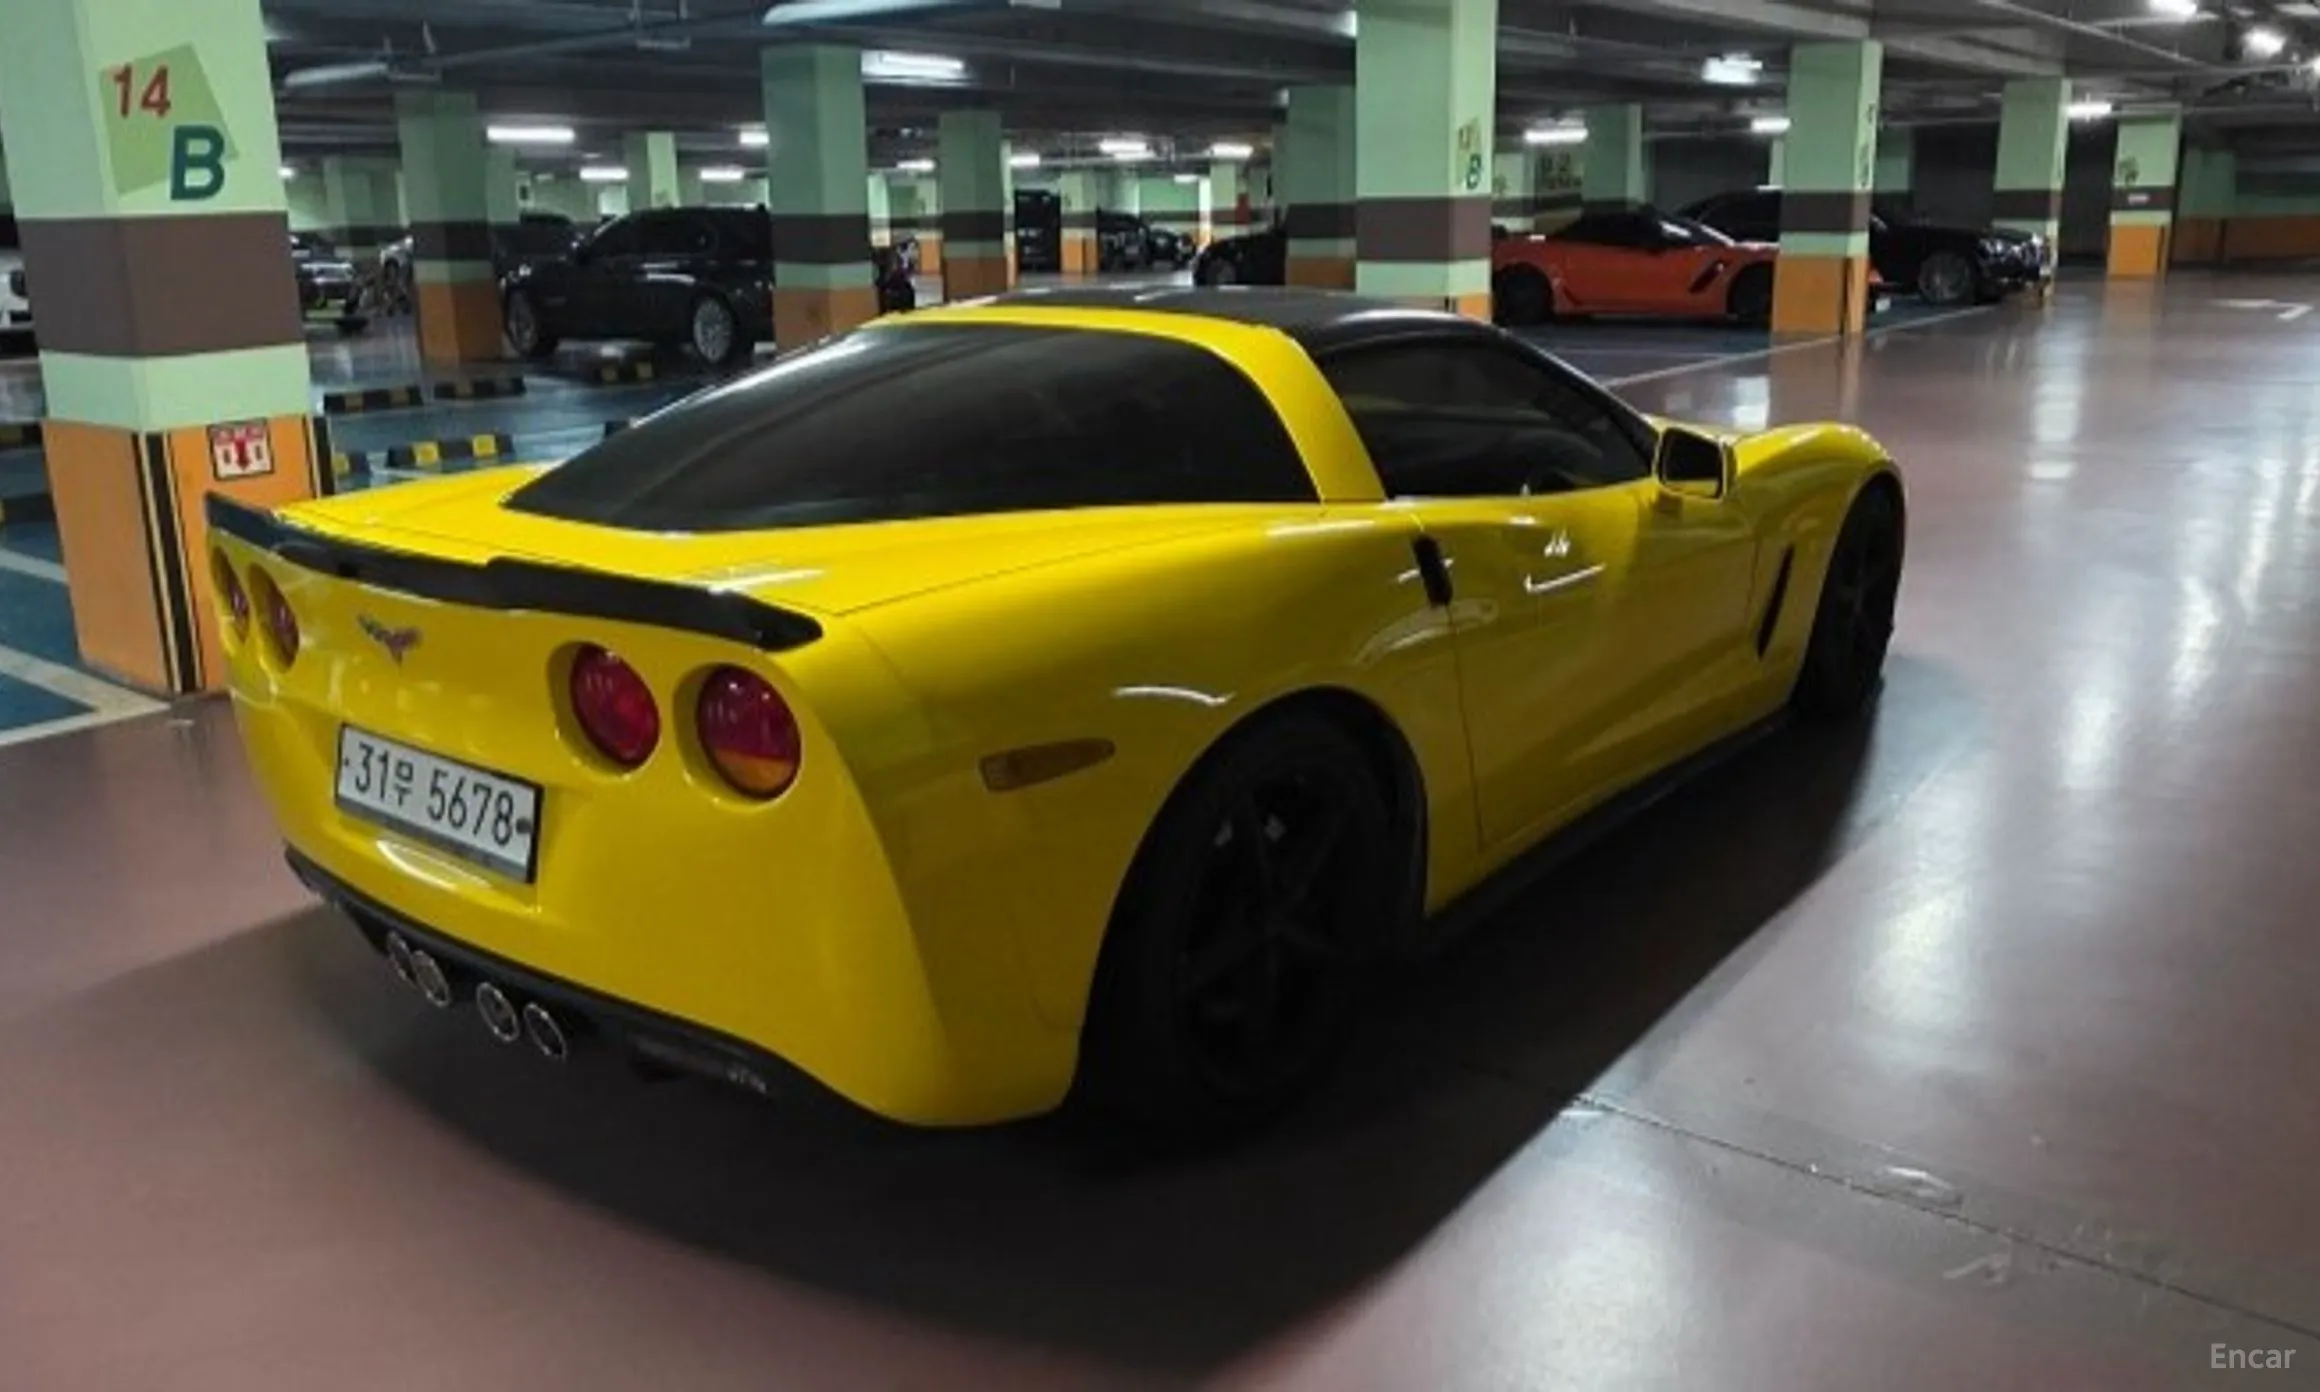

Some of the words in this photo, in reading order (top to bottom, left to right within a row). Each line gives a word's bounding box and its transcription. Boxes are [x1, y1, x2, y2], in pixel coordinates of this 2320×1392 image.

[113, 63, 172, 118] 14
[171, 125, 225, 200] B
[355, 741, 414, 807] 31무
[426, 767, 514, 846] 5678
